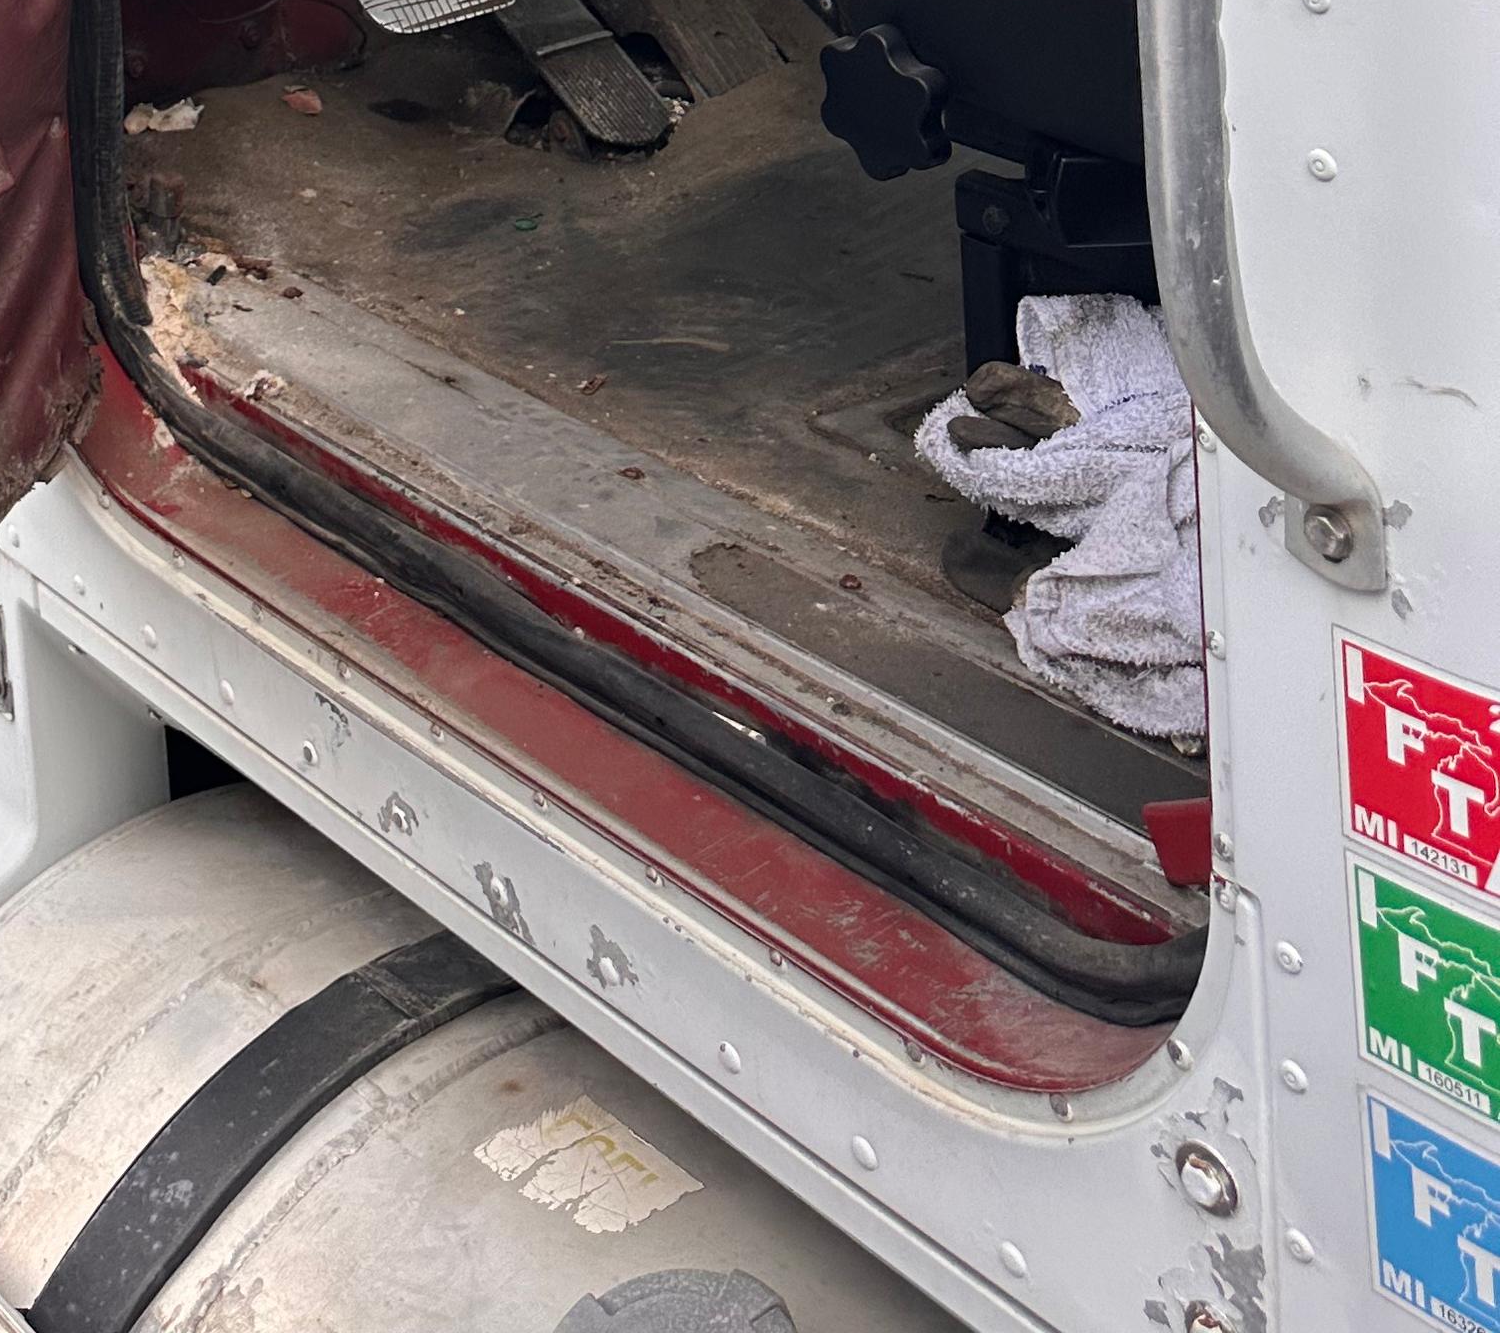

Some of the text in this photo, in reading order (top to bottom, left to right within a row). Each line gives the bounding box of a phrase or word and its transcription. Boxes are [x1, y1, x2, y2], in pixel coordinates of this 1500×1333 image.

[1354, 804, 1470, 879] MI 142131
[1369, 1026, 1482, 1107] MI 160511
[1382, 1259, 1426, 1309] MI
